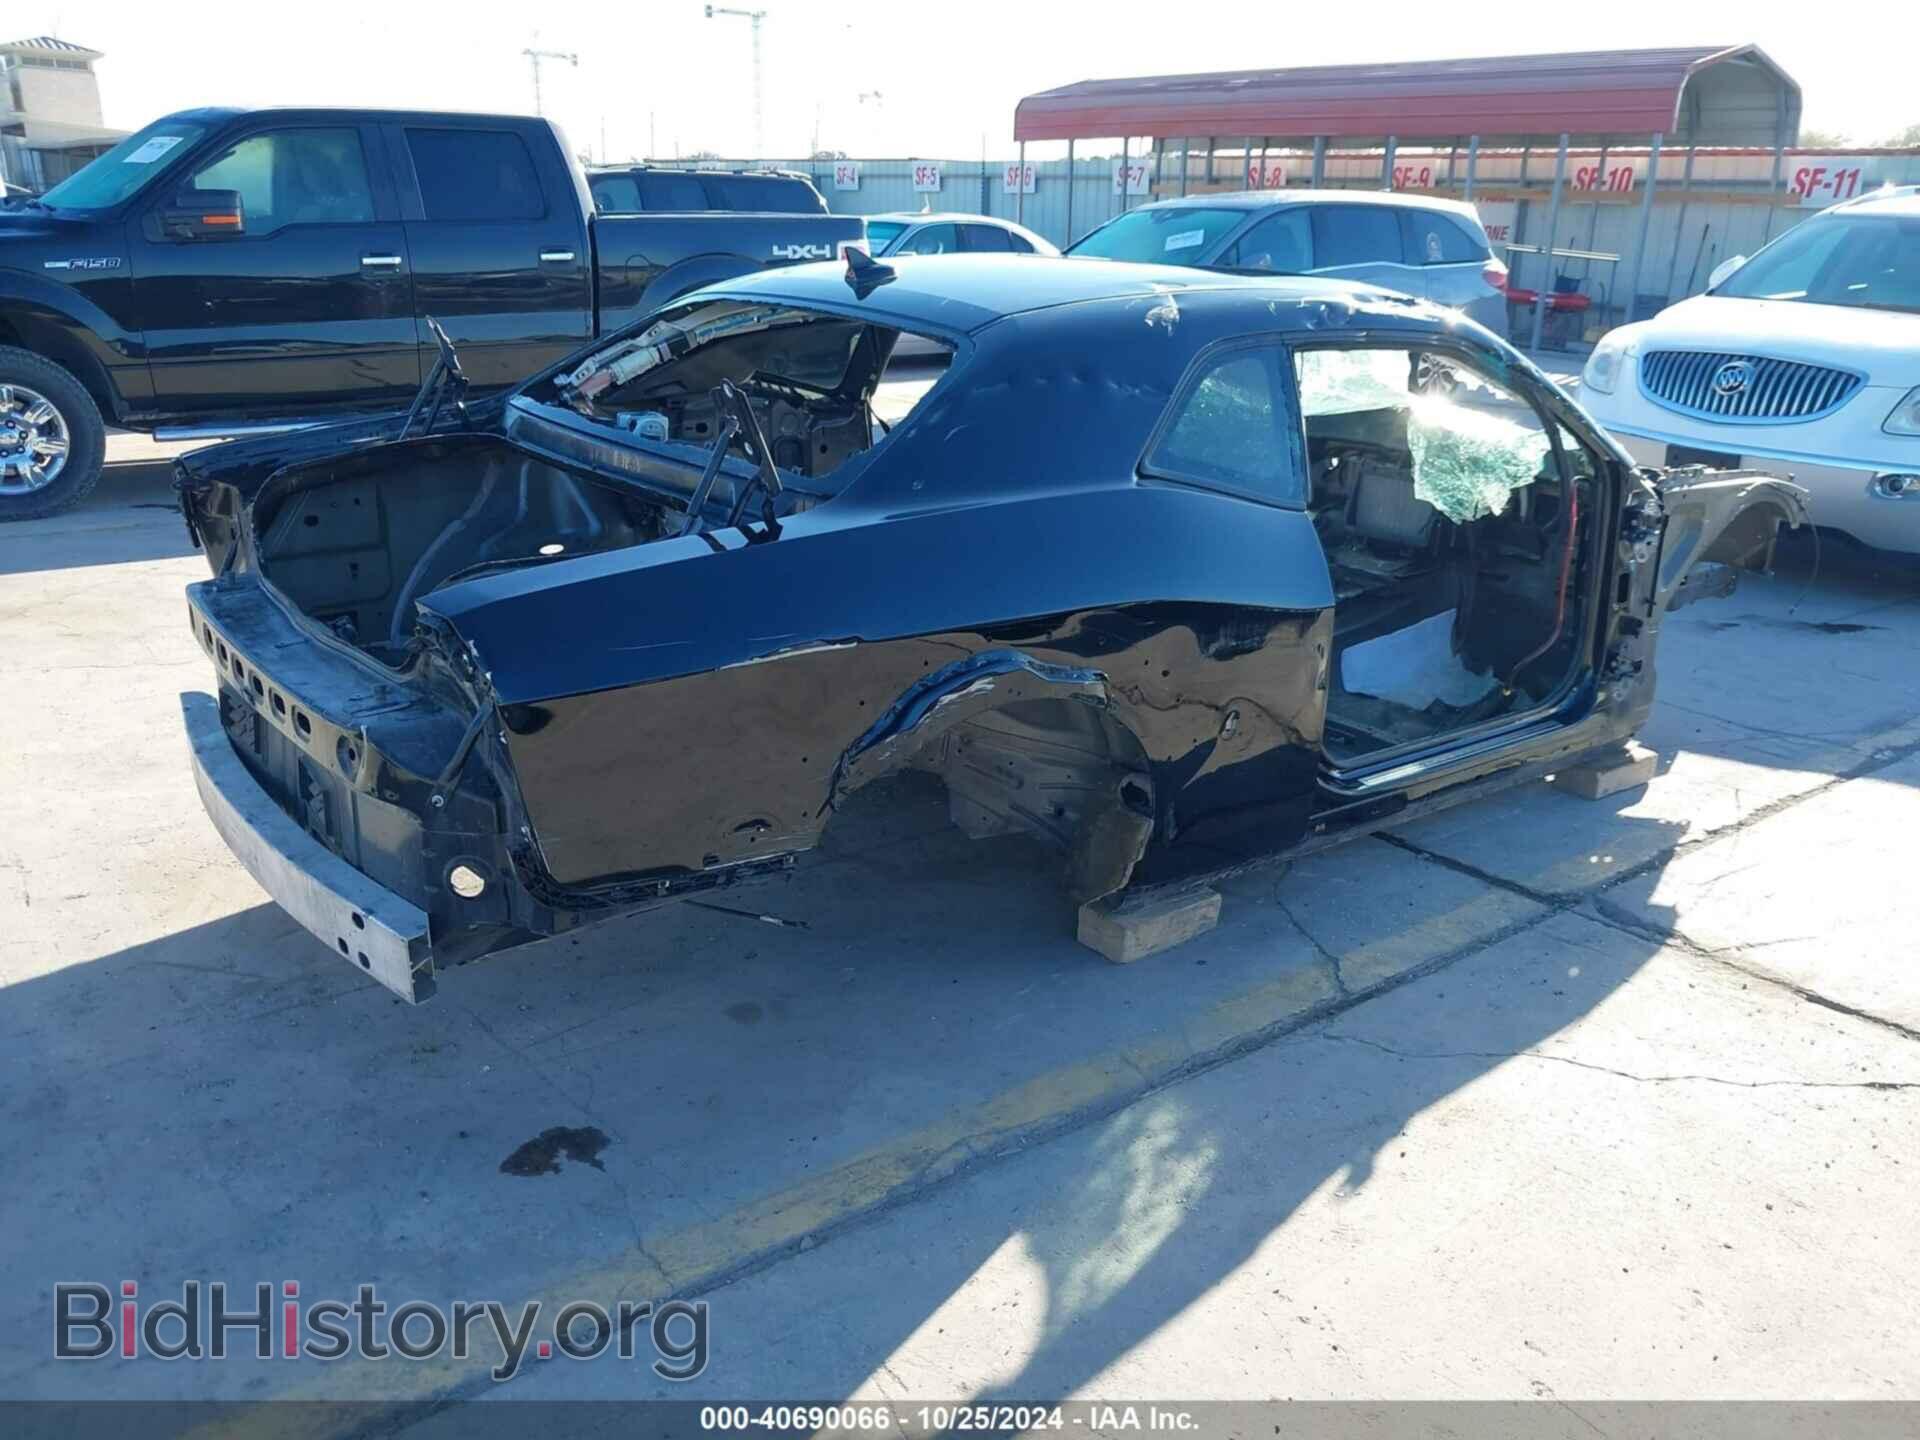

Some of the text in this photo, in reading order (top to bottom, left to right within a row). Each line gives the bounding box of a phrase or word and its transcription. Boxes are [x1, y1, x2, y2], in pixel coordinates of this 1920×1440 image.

[836, 167, 856, 185] SF-4
[914, 166, 936, 185] SF-5
[1007, 166, 1032, 186] SF6
[1392, 166, 1431, 190] SF-9
[1573, 166, 1633, 192] SF-10
[1790, 167, 1861, 198] SF-11
